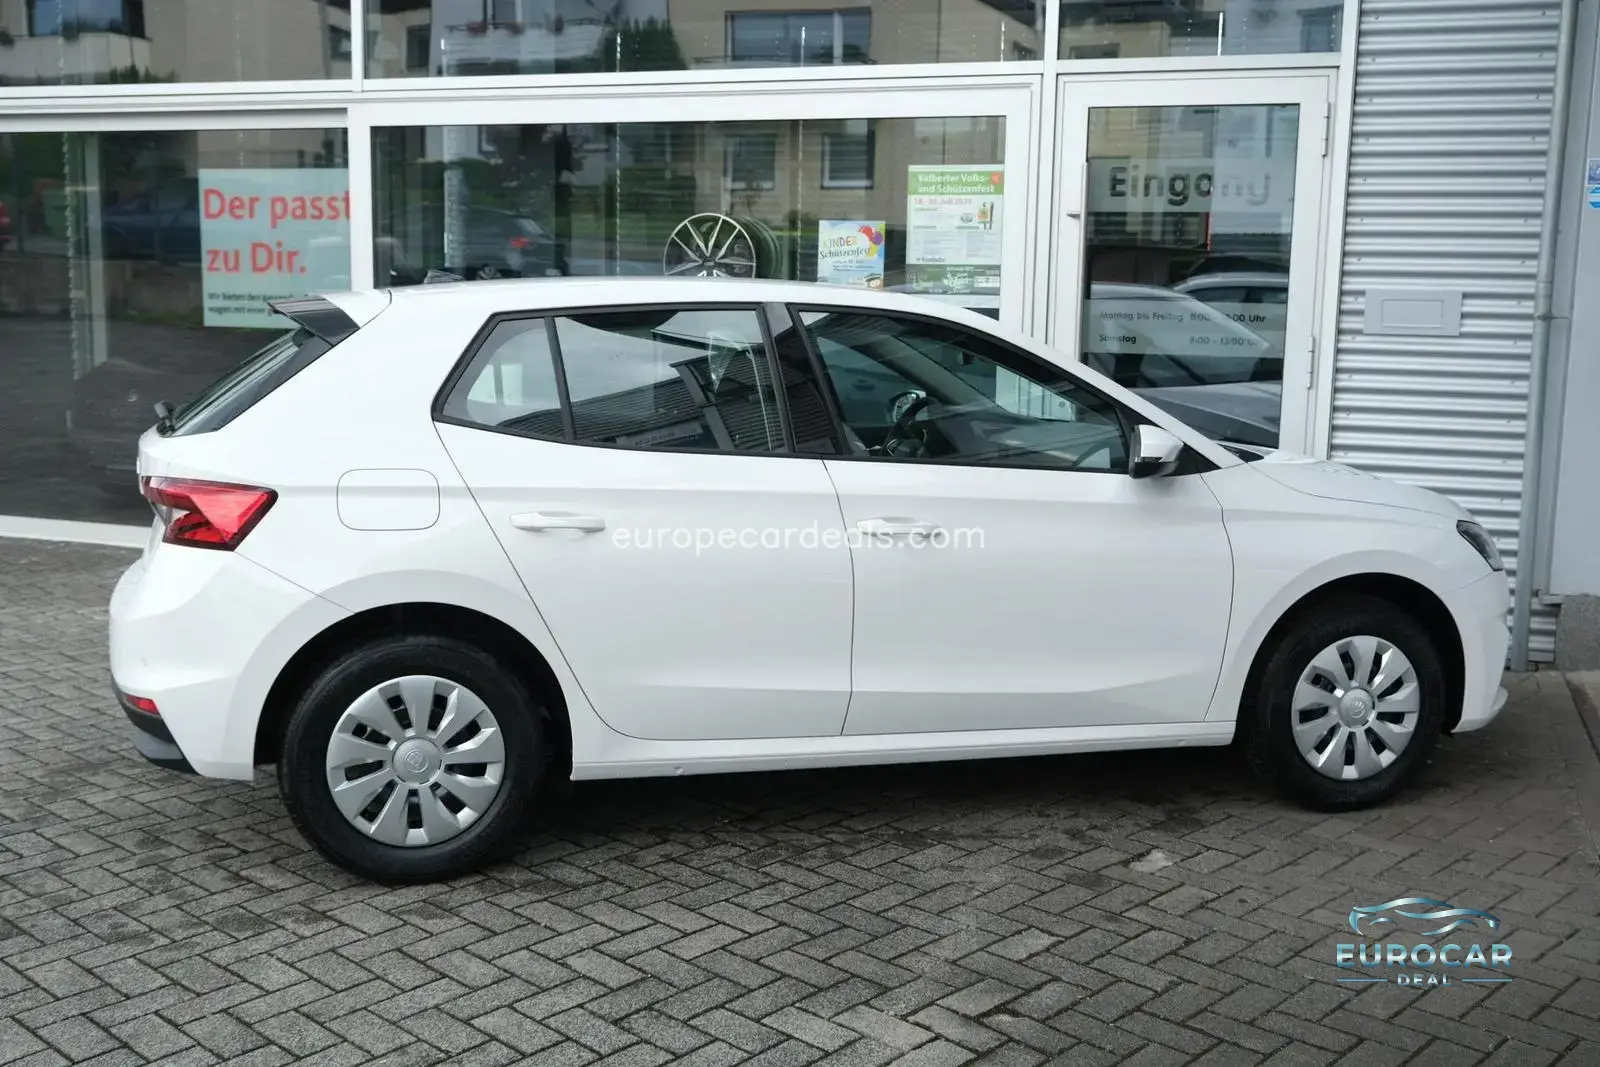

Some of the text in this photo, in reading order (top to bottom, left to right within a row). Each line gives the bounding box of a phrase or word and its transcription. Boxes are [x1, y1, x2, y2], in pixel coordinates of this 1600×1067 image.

[203, 188, 261, 219] Der
[206, 240, 307, 273] zu Dir.
[1100, 311, 1134, 321] Montag
[1137, 311, 1150, 320] bis
[1152, 311, 1184, 322] Freitag
[1248, 312, 1267, 323] Uhr
[1099, 334, 1137, 345] Samstag
